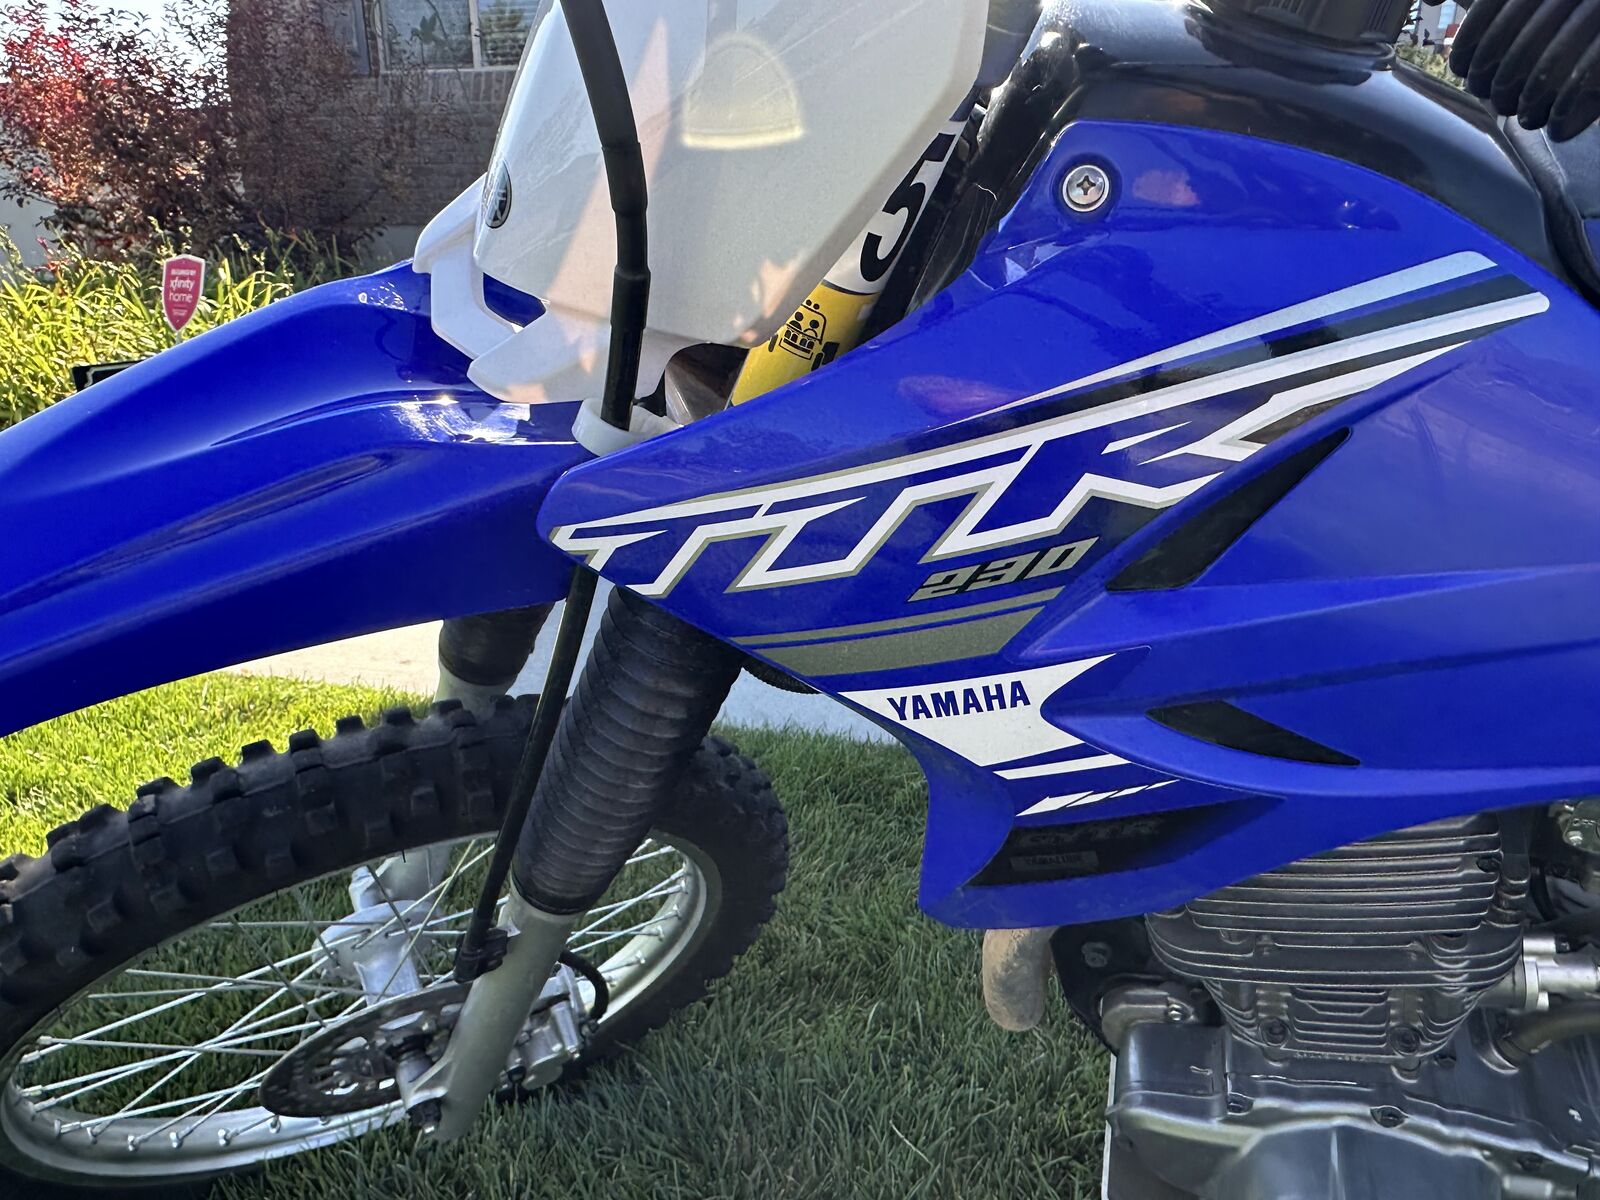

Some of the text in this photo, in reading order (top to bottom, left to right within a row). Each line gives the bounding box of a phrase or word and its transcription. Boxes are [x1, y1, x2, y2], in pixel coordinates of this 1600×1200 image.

[169, 291, 193, 303] home
[907, 536, 1100, 602] 230
[886, 679, 1032, 721] YAMAHA
